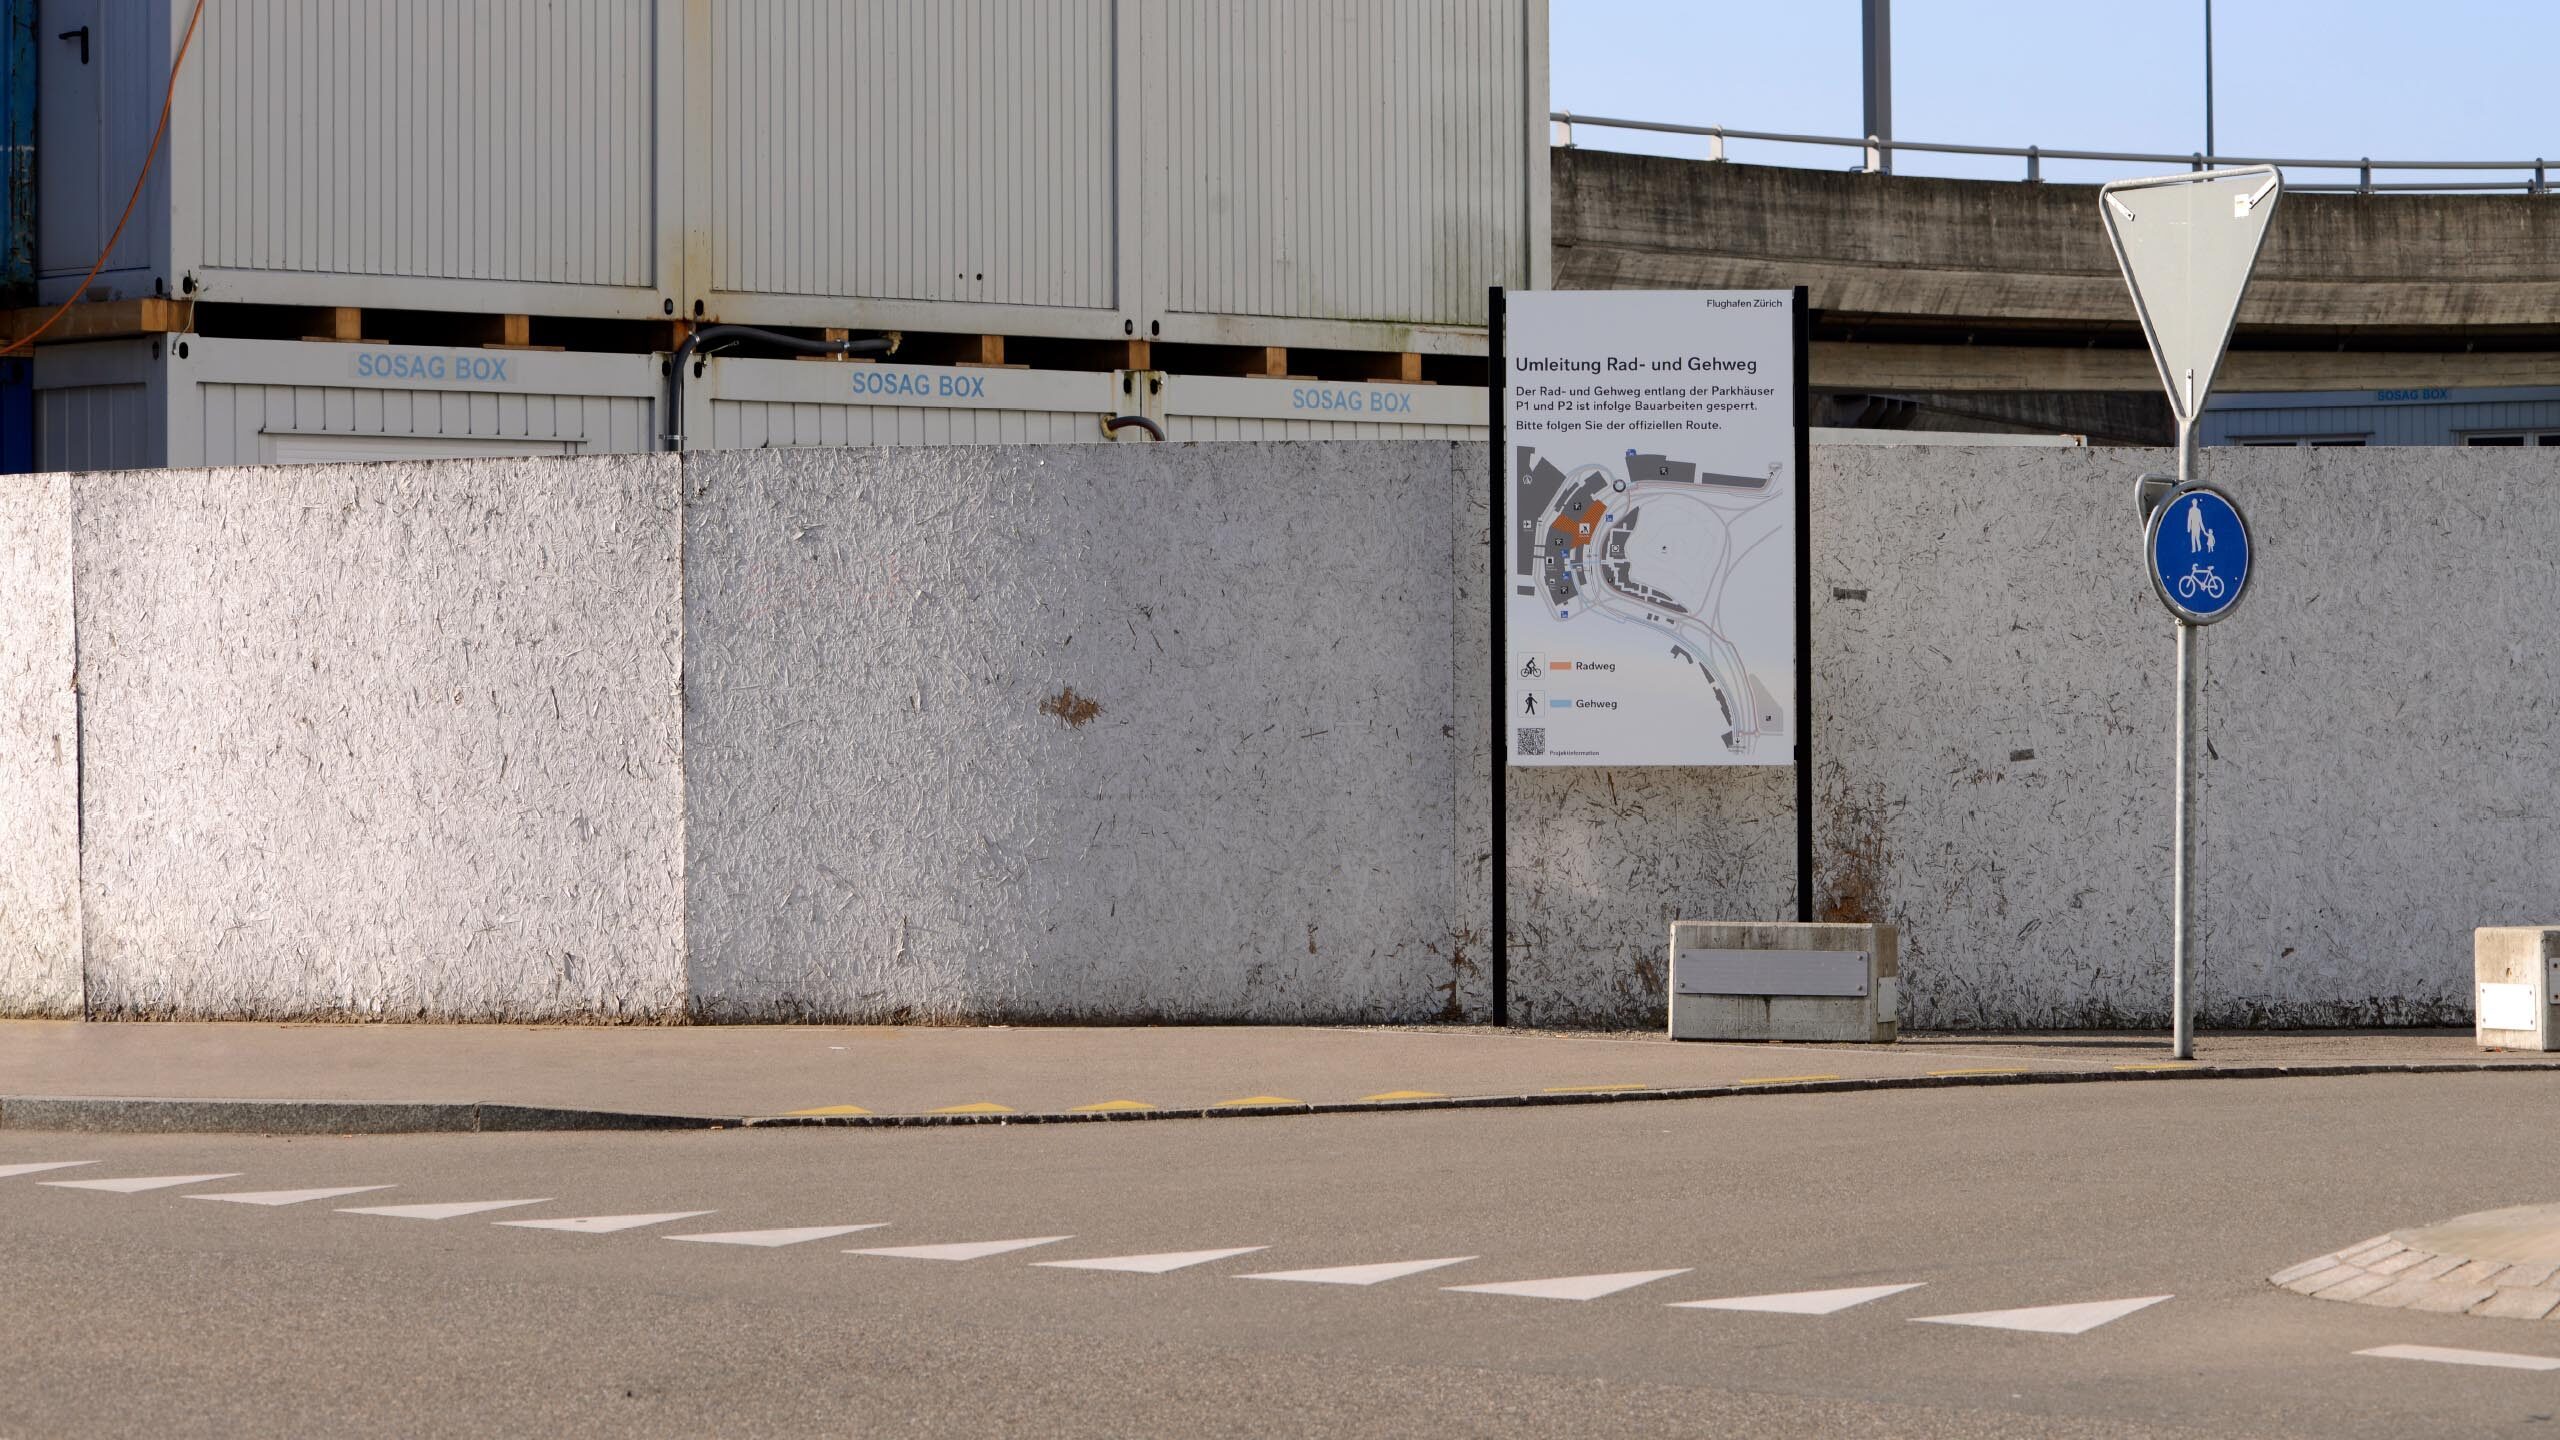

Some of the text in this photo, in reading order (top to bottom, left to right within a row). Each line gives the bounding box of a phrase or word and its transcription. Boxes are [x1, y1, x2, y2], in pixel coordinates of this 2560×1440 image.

[1706, 298, 1783, 310] Flughafen Zürich
[358, 353, 508, 382] SOSAG BOX
[1515, 356, 1757, 375] Umleitung Rad- und Gehweg
[852, 372, 985, 398] SOSAG BOX
[1515, 385, 1775, 399] Der Rad- und Gehweg entlang der Parkhäuser
[1292, 388, 1412, 413] SOSAG BOX
[2377, 387, 2449, 401] SOSAG BOX
[1516, 400, 1758, 413] P1 und P2 ist infolge Bauarbeiten gesperrt.
[1516, 420, 1722, 433] Bitte folgen Sie der offiziellen Route.
[1575, 660, 1616, 673] Radweg
[1575, 699, 1618, 711] Gehweg
